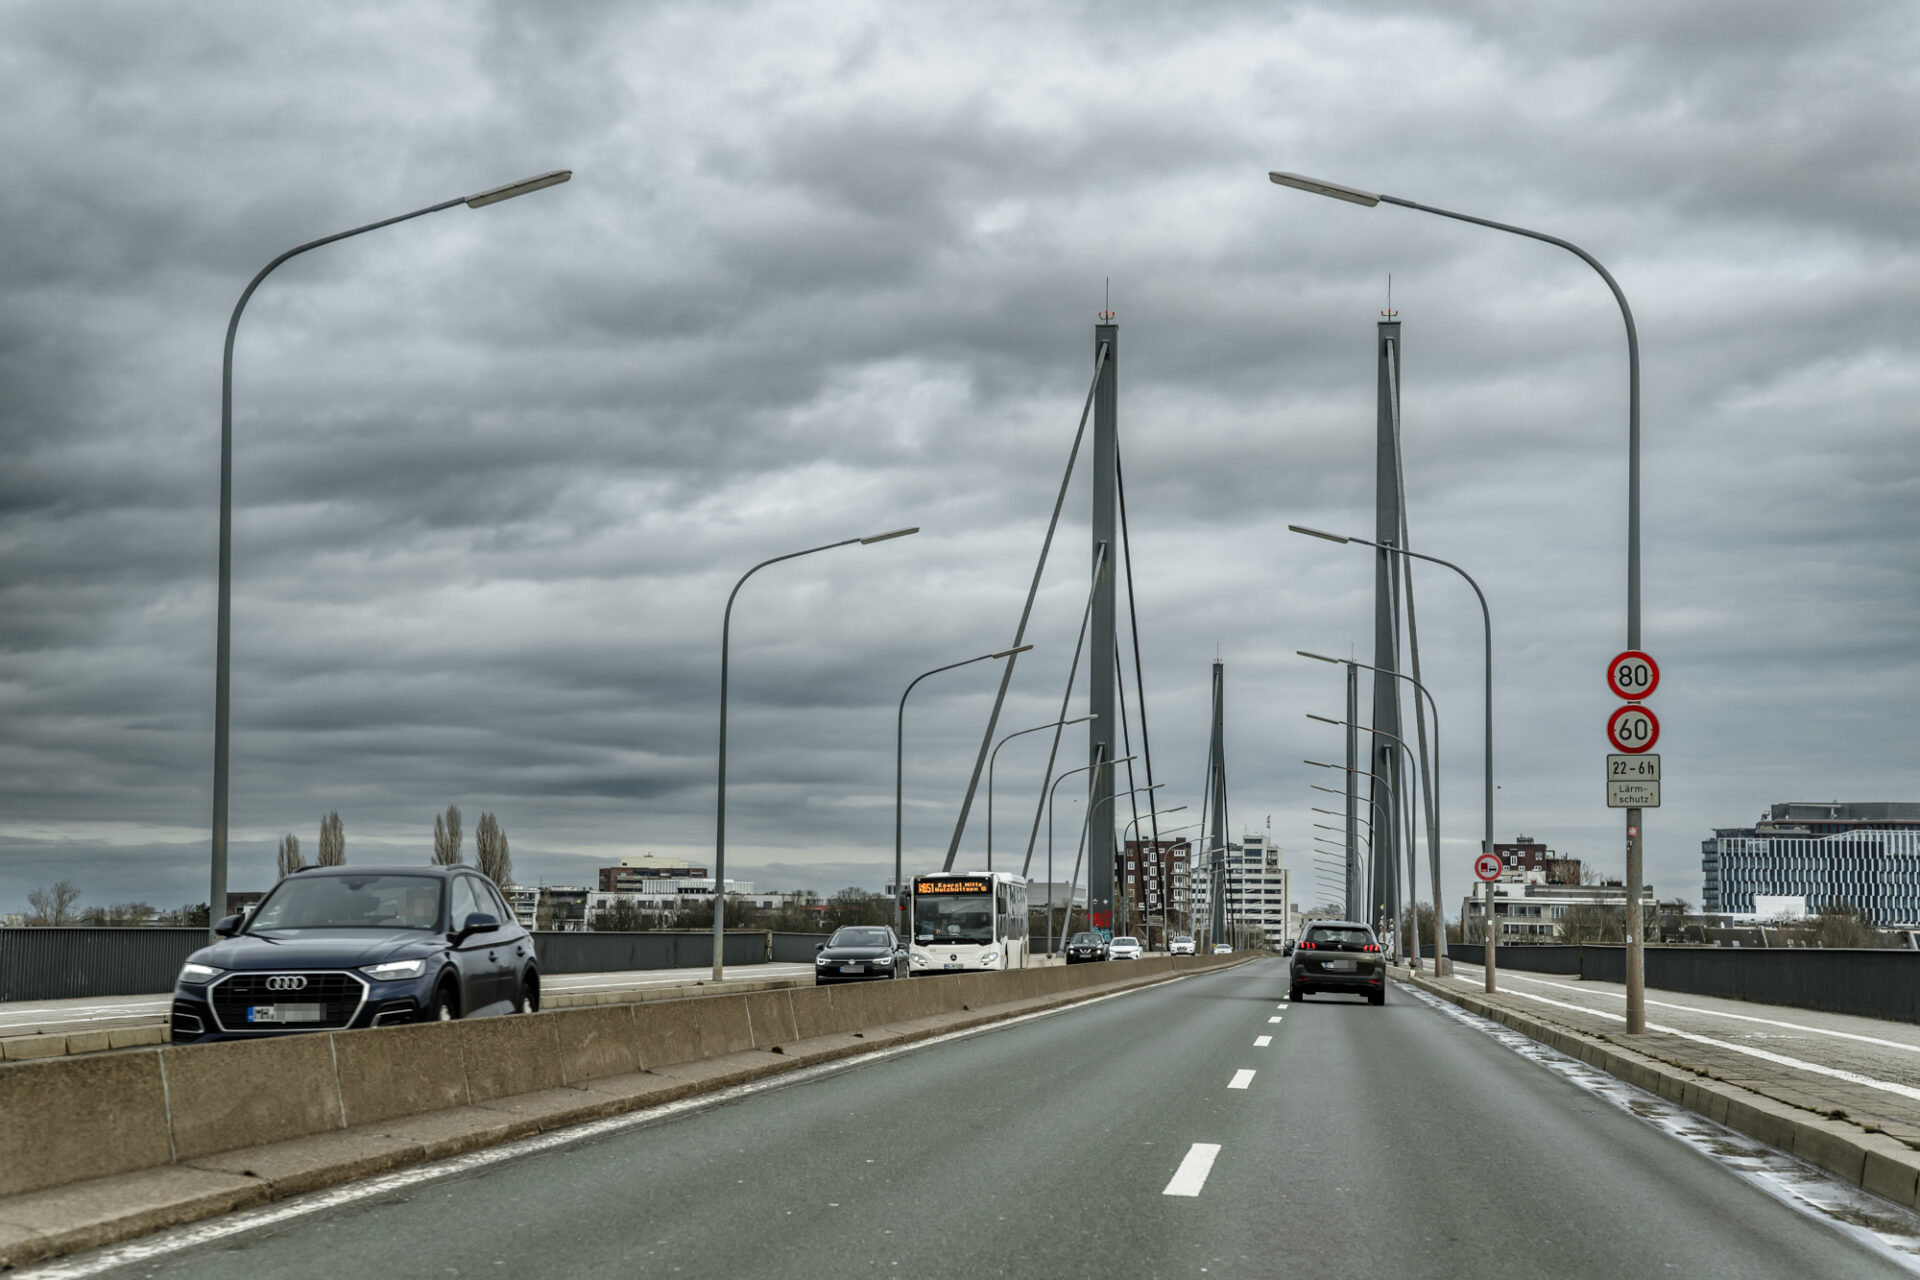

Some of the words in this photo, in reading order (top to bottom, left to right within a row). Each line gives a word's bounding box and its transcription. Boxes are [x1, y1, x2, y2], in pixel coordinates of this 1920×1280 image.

[1618, 664, 1648, 687] 80
[1618, 718, 1648, 741] 60
[1619, 785, 1648, 793] Lärm-
[1619, 795, 1649, 803] schutz
